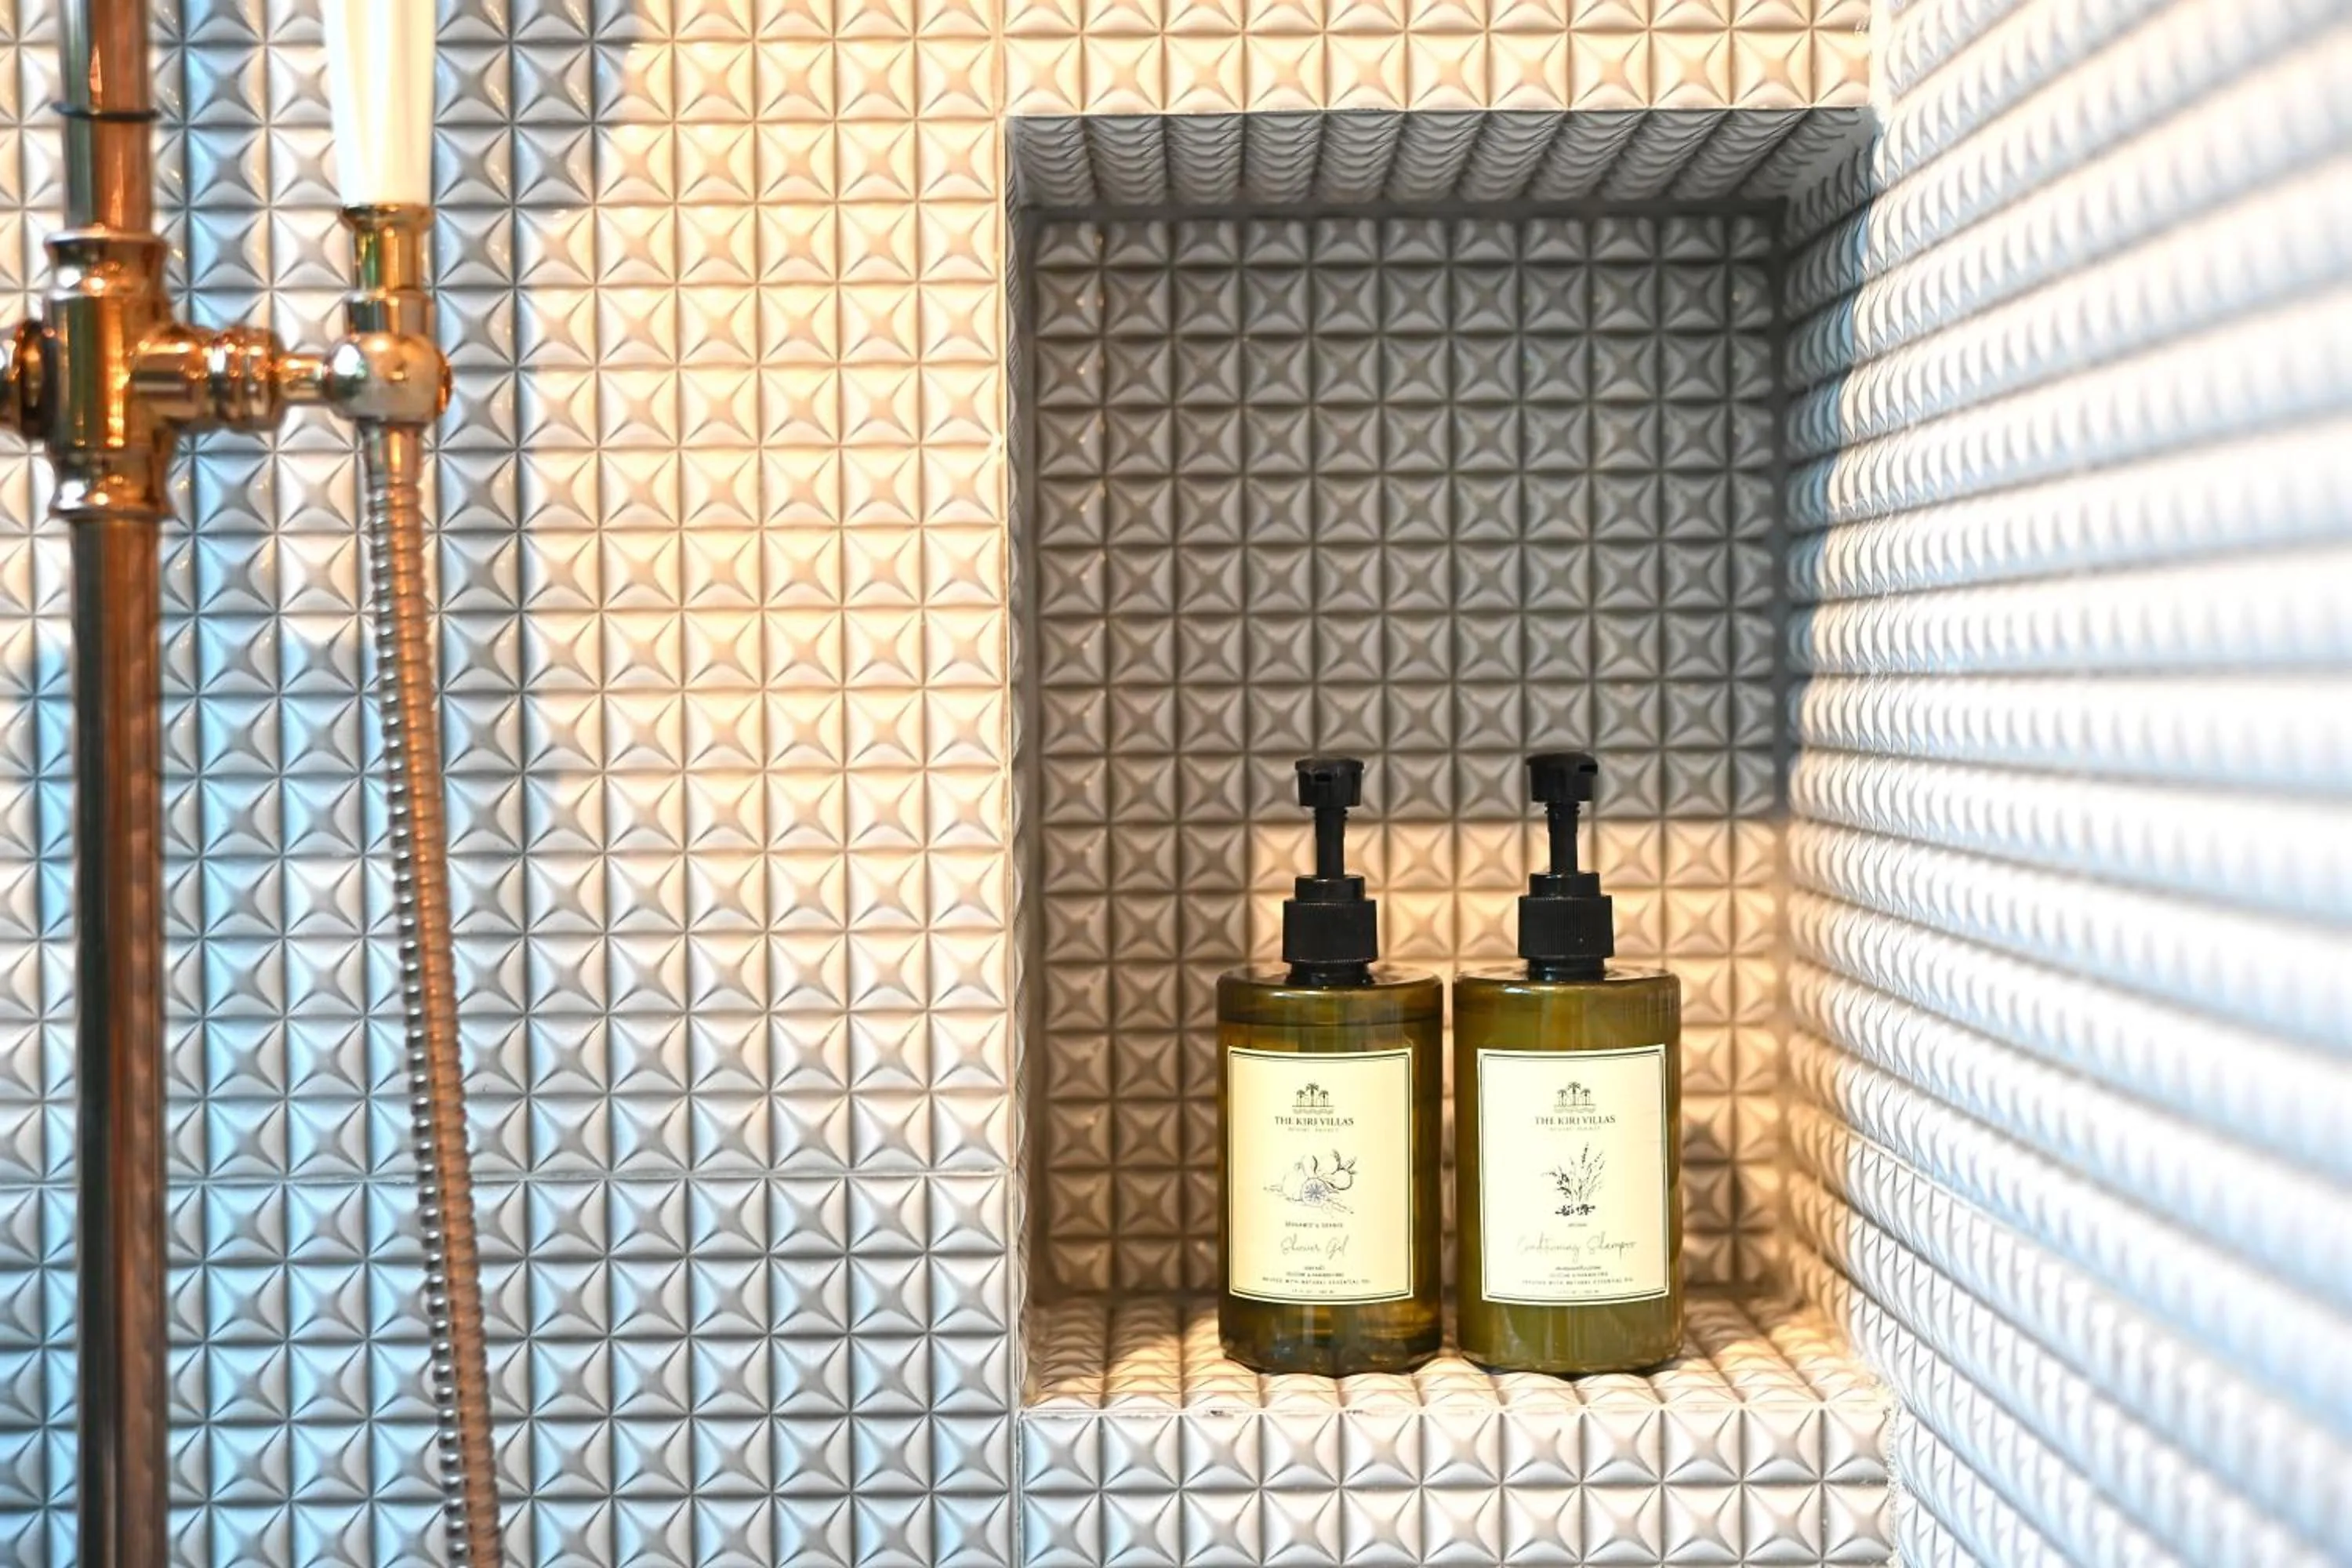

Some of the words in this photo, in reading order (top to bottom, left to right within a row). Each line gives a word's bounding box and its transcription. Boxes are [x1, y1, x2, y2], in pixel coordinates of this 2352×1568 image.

[1275, 1116, 1294, 1125] THE
[1319, 1116, 1354, 1126] VILLAS
[1534, 1116, 1555, 1126] THE
[1558, 1116, 1580, 1126] KIRI
[1581, 1114, 1616, 1125] VILLAS
